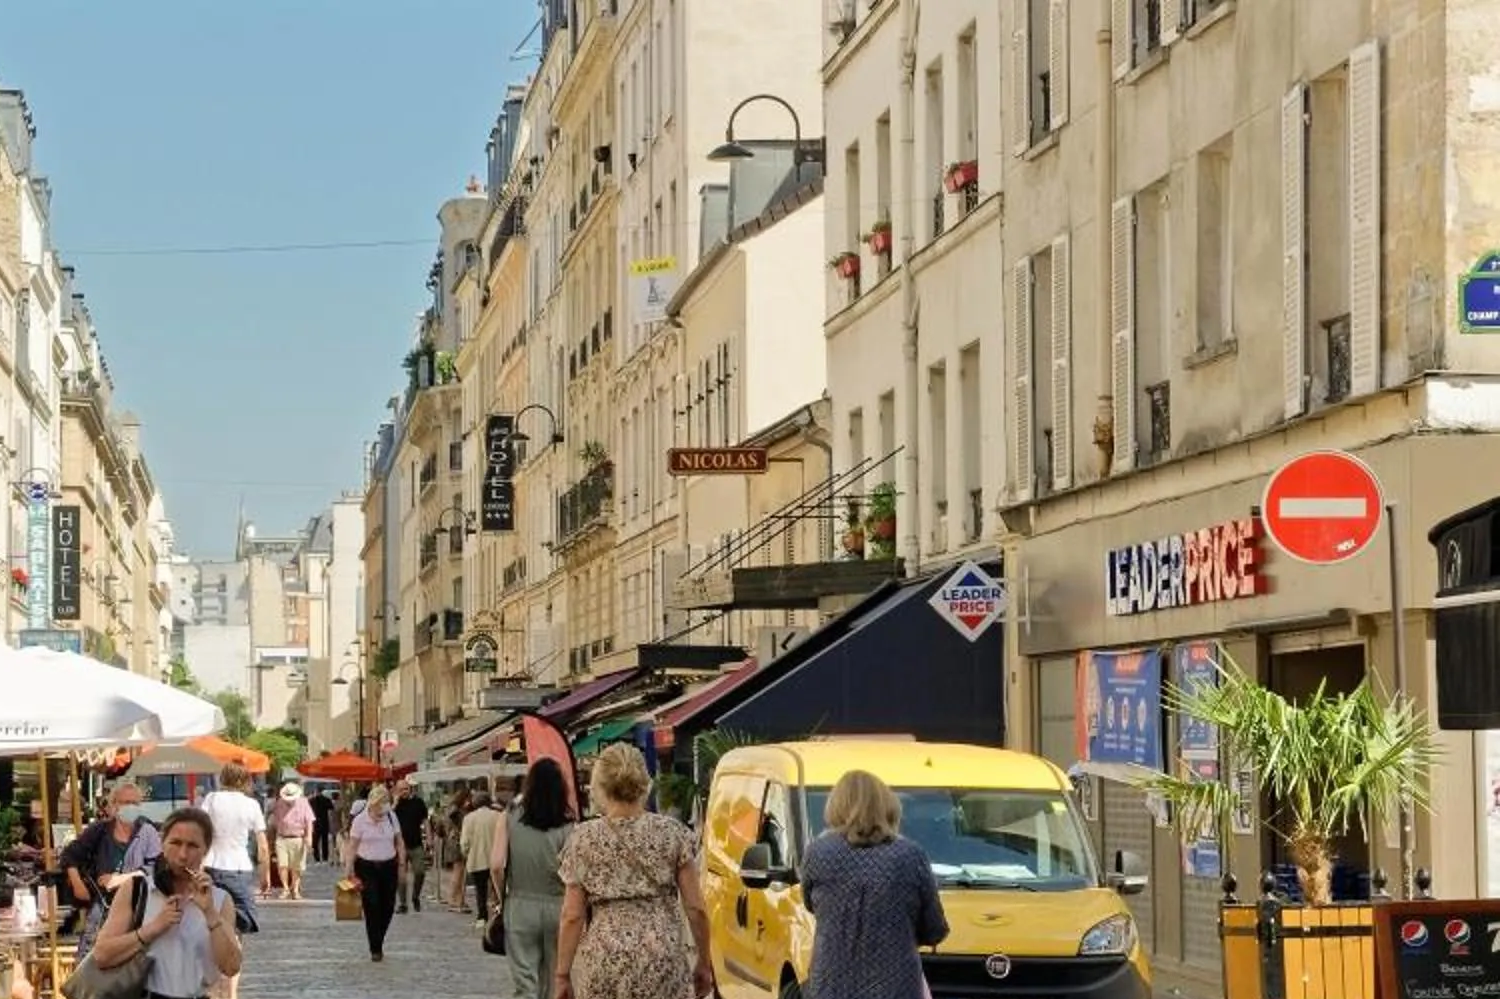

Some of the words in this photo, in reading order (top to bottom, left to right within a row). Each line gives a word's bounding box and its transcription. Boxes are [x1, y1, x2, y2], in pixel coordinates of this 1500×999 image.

[489, 438, 508, 499] HOTEL
[679, 451, 758, 469] NICOLAS
[58, 511, 73, 602] HOTEL
[942, 588, 1001, 601] LEADER
[950, 601, 995, 613] PRICE
